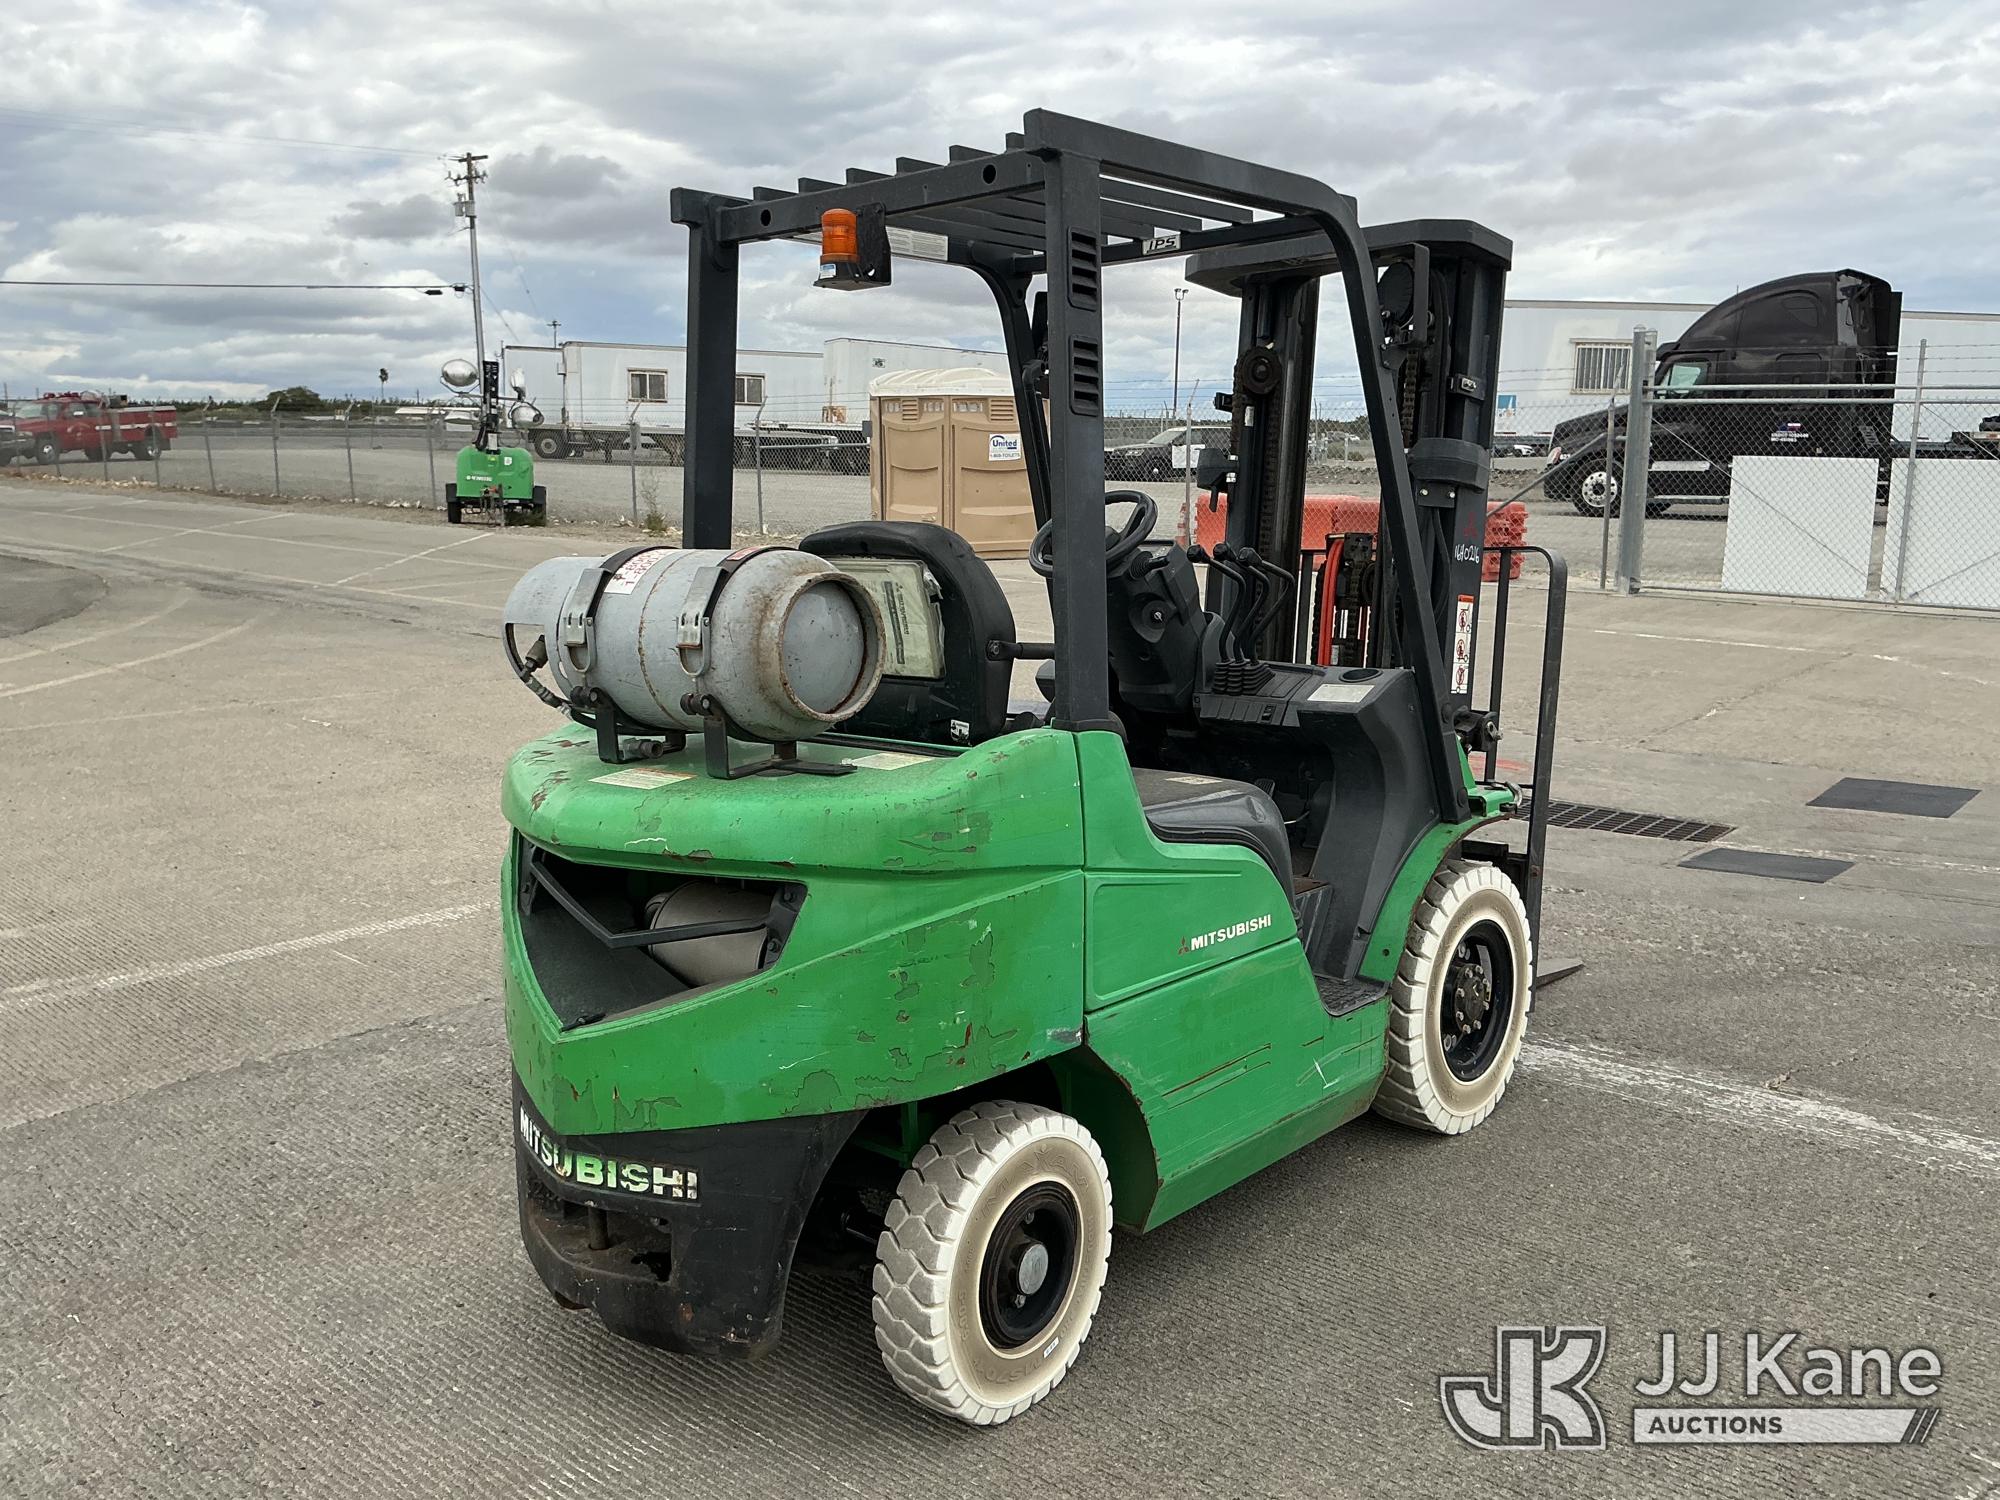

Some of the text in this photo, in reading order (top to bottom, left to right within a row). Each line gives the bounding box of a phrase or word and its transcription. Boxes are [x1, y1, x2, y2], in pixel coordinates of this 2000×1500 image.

[992, 438, 1018, 448] United
[1190, 914, 1272, 951] MITSUBISHI
[520, 1106, 698, 1200] MITSUBISHI
